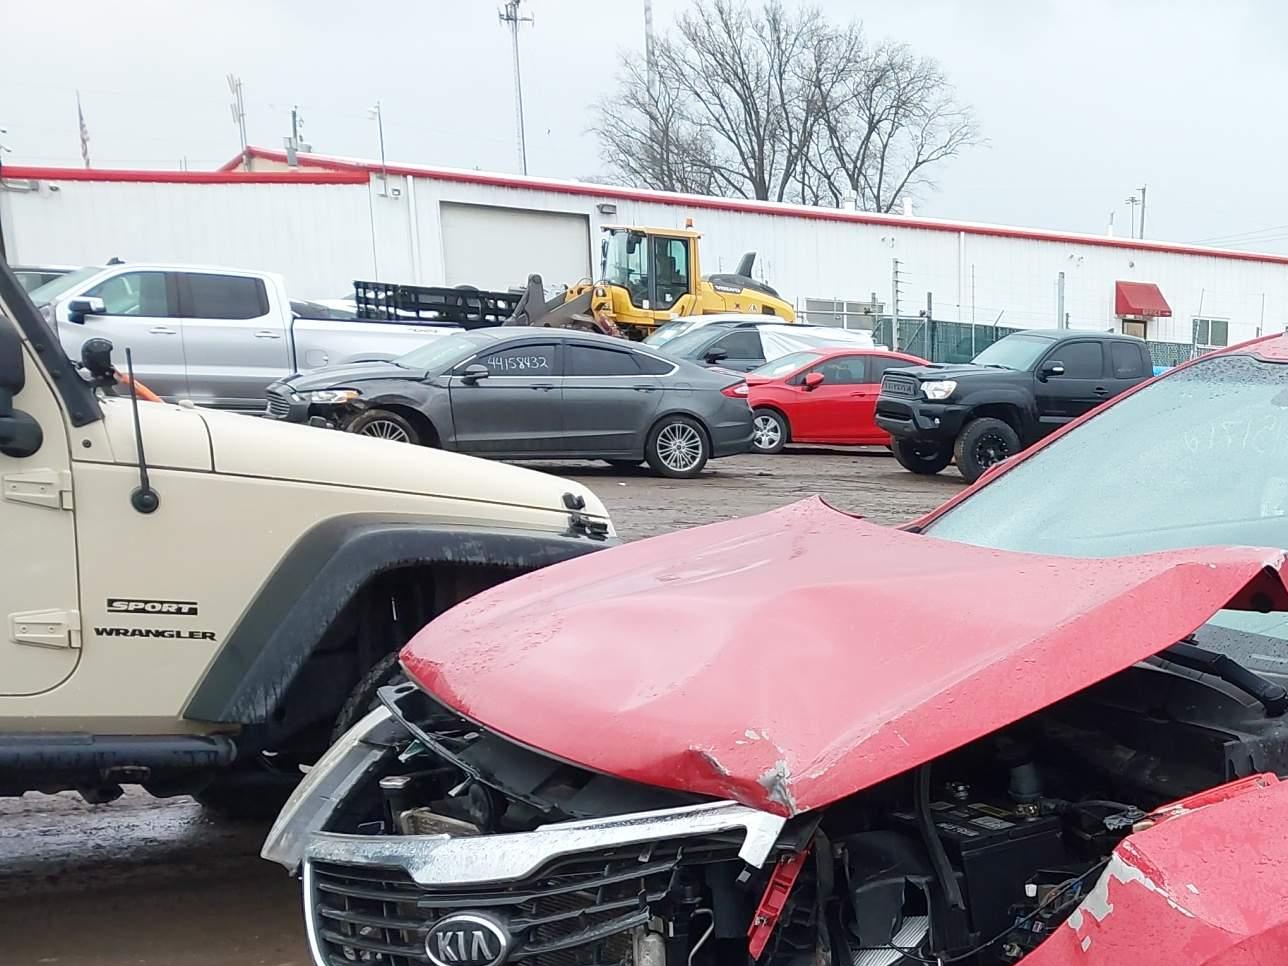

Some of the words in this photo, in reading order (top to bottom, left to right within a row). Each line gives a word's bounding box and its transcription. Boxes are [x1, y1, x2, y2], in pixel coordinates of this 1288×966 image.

[487, 357, 549, 371] 44158432
[112, 600, 195, 613] SPORT
[93, 627, 217, 641] WRANGLER
[435, 930, 496, 961] KIA
